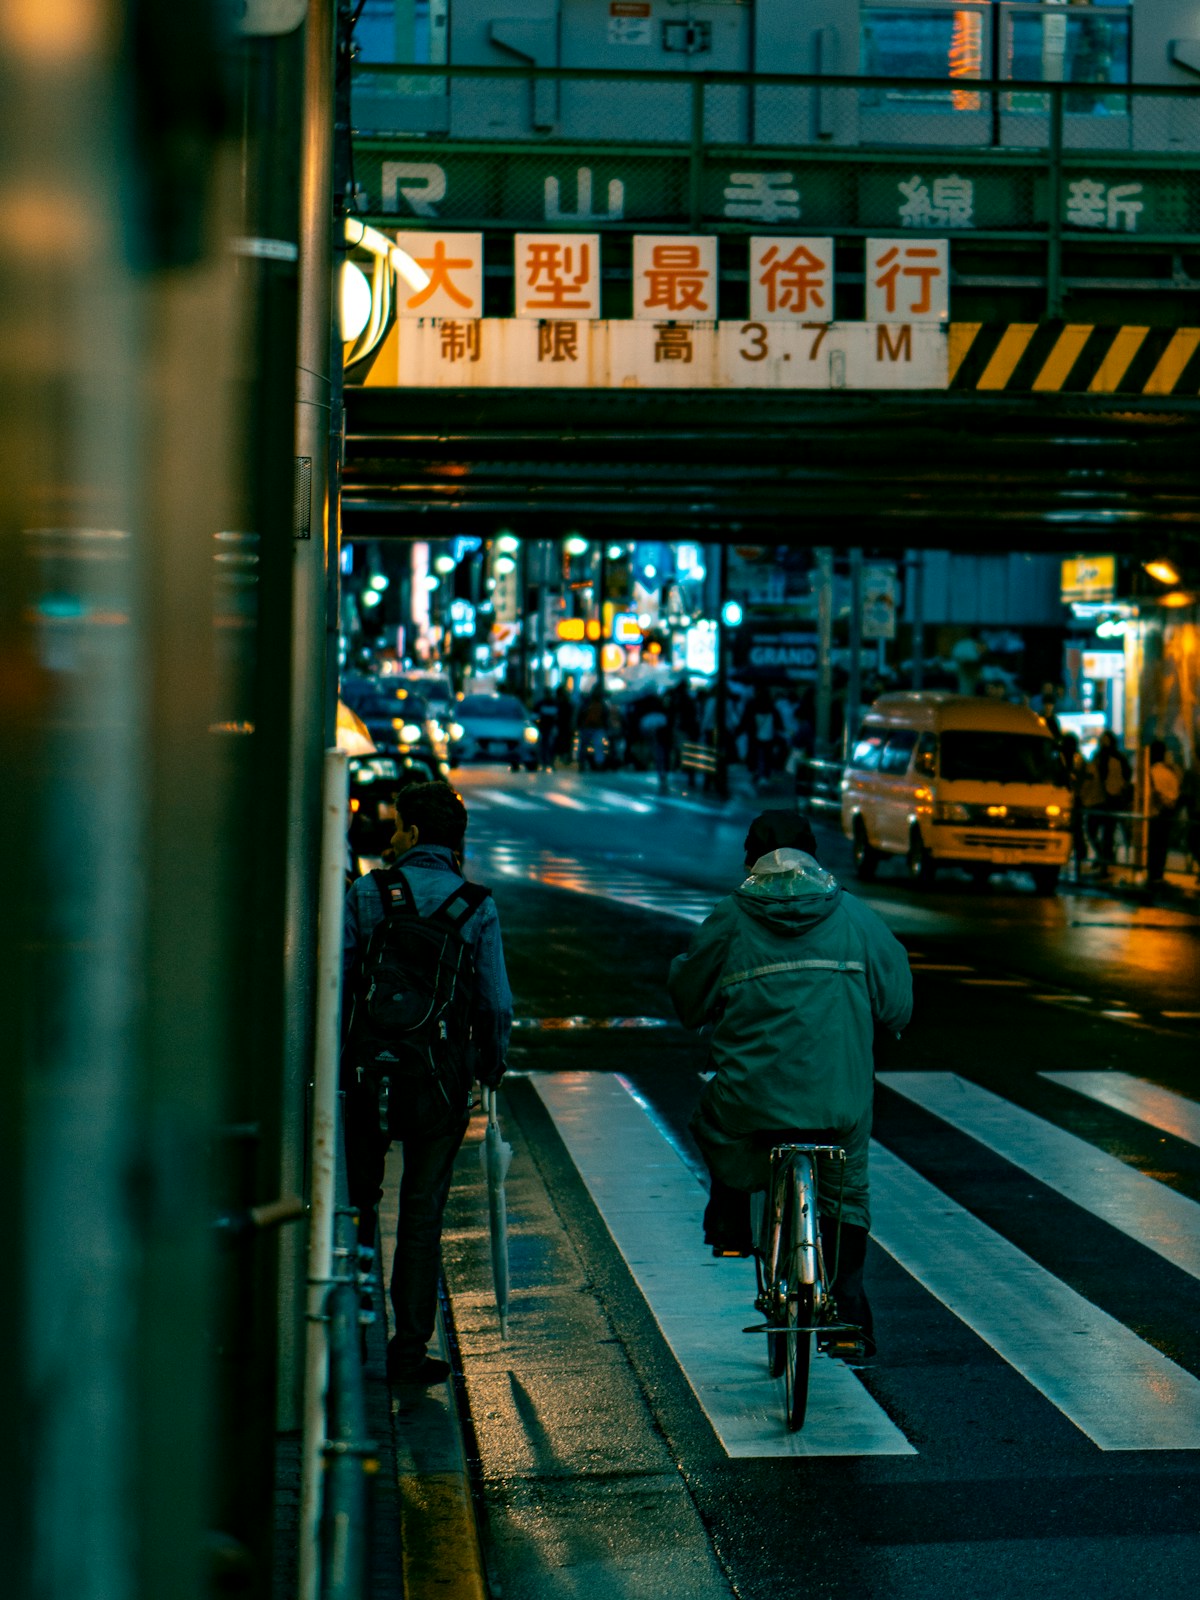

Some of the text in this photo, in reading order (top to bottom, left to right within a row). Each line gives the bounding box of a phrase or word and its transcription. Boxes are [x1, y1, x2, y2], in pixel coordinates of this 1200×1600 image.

[407, 240, 942, 313] 大型最徐行
